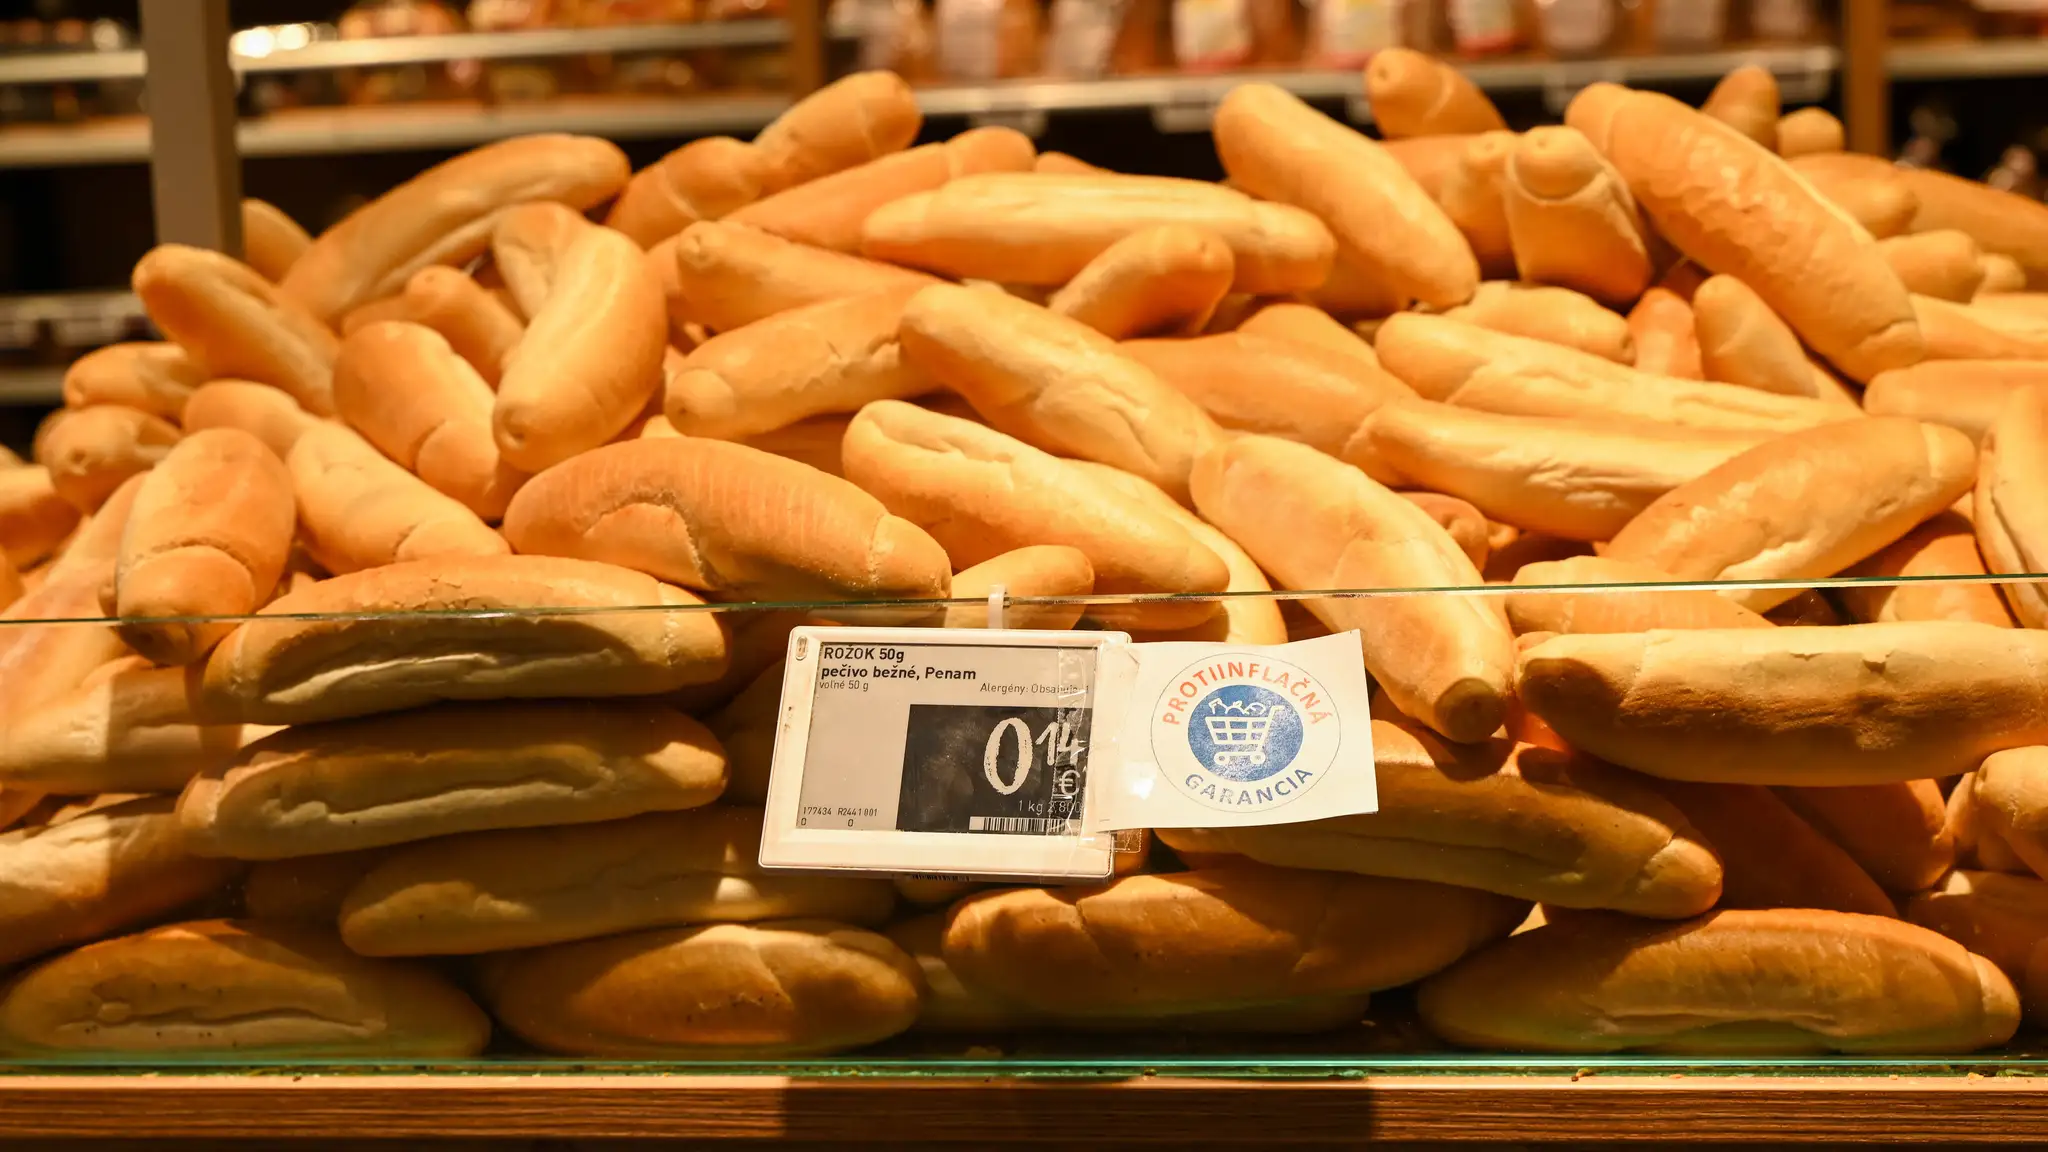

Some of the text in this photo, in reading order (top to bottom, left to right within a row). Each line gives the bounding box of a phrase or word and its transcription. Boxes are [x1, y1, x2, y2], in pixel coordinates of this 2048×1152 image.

[824, 645, 904, 663] ROŽOK 50g
[821, 664, 976, 681] pečivo bežné, Penam
[848, 681, 860, 690] 50
[863, 683, 869, 692] g
[980, 683, 1028, 695] Alergény:
[1163, 661, 1333, 725] PROTIINFLAČNÁ
[1059, 769, 1081, 796] €
[1185, 769, 1313, 805] GARANCIA
[803, 806, 832, 815] 177434
[1028, 800, 1044, 815] kg
